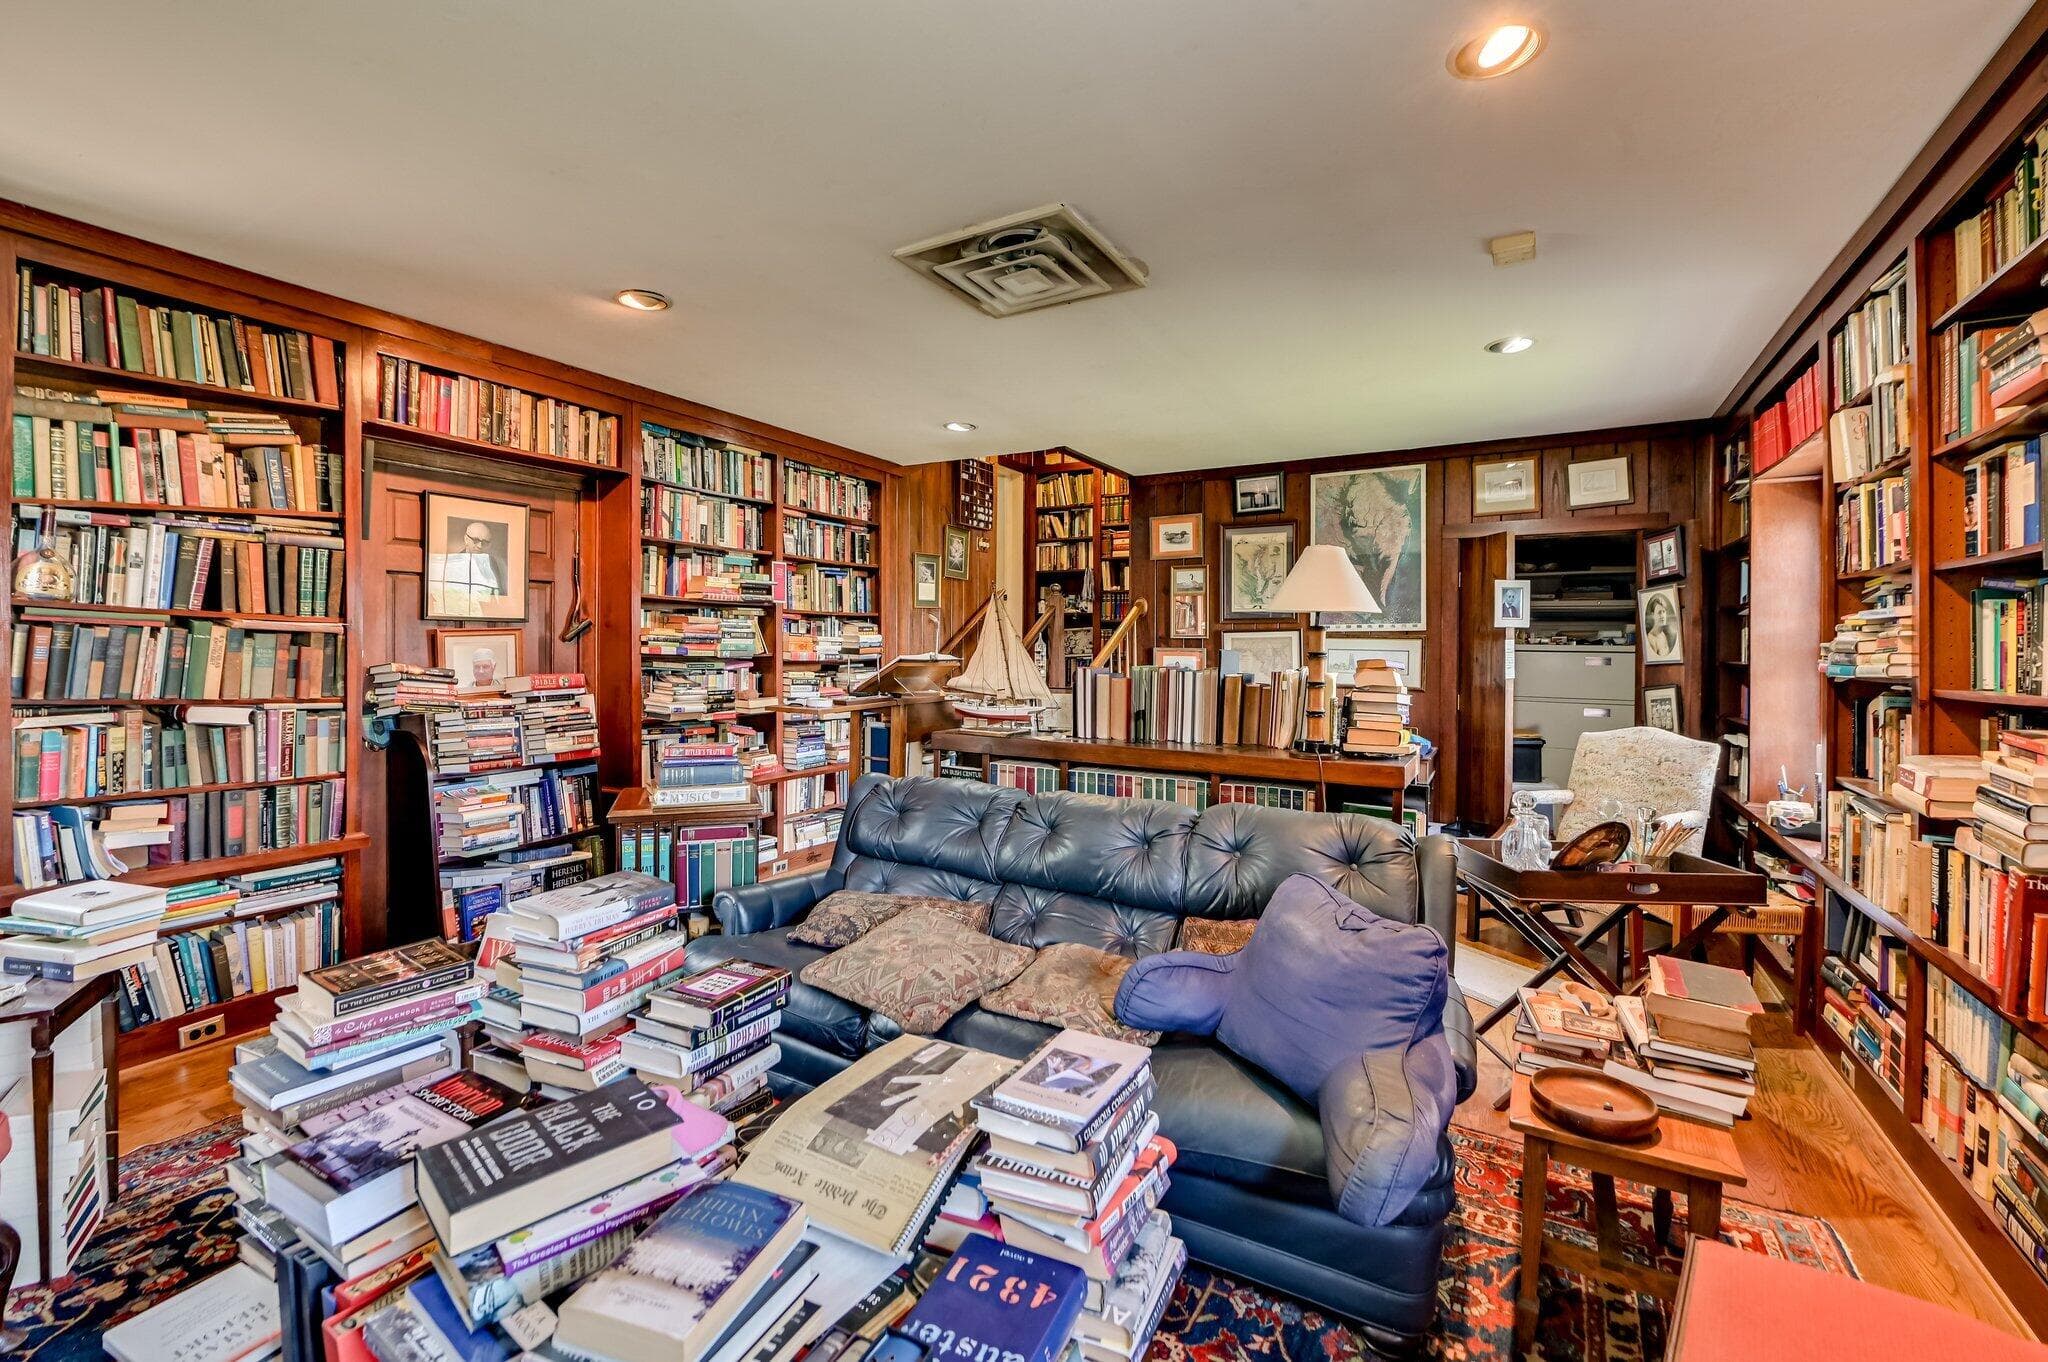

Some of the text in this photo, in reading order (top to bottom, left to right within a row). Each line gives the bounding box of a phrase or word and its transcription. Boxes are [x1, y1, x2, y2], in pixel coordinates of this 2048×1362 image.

[535, 678, 557, 686] BIBLE
[670, 791, 710, 803] MUSIC
[552, 864, 584, 879] HERESIES
[552, 875, 584, 890] HERETICS
[339, 974, 455, 1011] IN THE GARDEN OF BEASTS LARSON
[379, 1006, 421, 1026] SPLENDOR
[729, 1015, 770, 1049] UPHEAVAL
[701, 1049, 747, 1080] STEPHEN KING
[414, 1088, 444, 1112] SHORT
[441, 1102, 479, 1123] STORY
[592, 1101, 623, 1123] THE
[535, 1101, 604, 1154] BLACK
[1083, 1111, 1111, 1142] GLORIOUS
[488, 1120, 553, 1172] DOOR
[774, 1160, 805, 1187] News
[814, 1178, 860, 1207] Peddie
[860, 1198, 888, 1222] The
[512, 1206, 651, 1270] The Greatest Minds in Psychology
[999, 1248, 1026, 1264] novel
